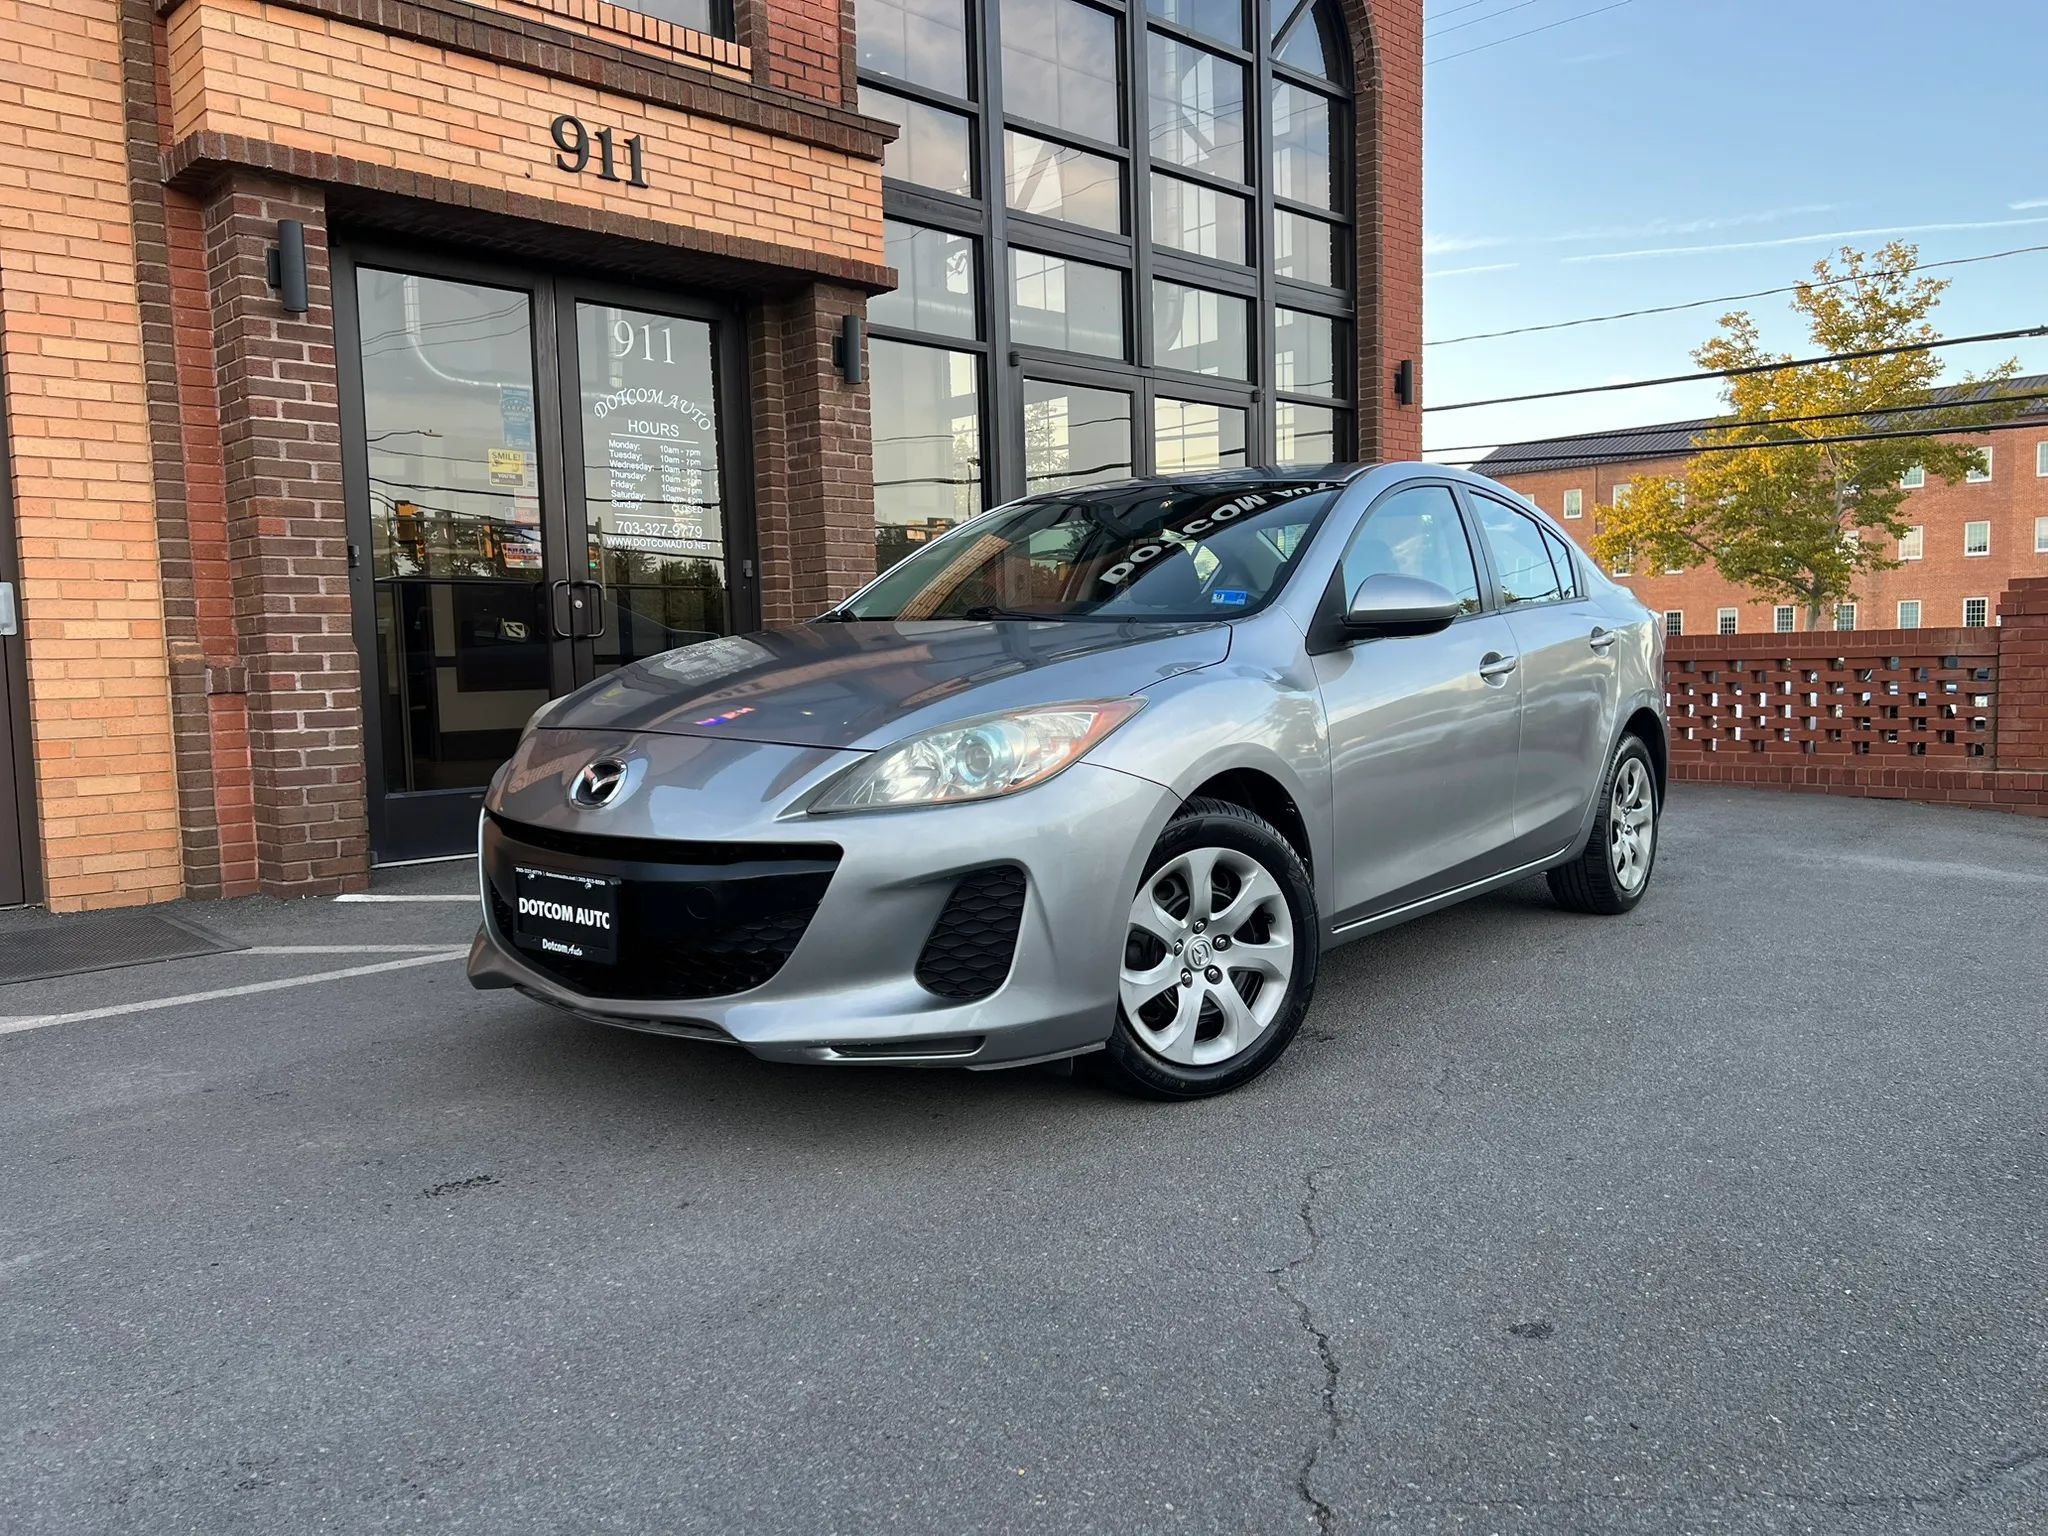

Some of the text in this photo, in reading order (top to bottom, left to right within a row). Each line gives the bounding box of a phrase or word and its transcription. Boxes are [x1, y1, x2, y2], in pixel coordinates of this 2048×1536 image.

[551, 115, 649, 189] 911
[613, 320, 676, 365] 911
[594, 387, 711, 431] DOTCOM AUTO
[628, 420, 679, 437] HOURS
[609, 440, 640, 450] Monday:
[660, 445, 679, 454] 10am
[492, 451, 520, 461] SMILE!
[609, 450, 642, 460] Tuesday:
[661, 455, 680, 464] 10am
[609, 460, 655, 471] Wednesday:
[661, 465, 680, 474] 10am
[610, 469, 647, 481] Thursday:
[661, 475, 681, 483] 10am
[610, 480, 636, 490] Friday:
[662, 484, 681, 493] 10am
[611, 490, 646, 500] Saturday:
[662, 494, 681, 502] 10am
[611, 500, 704, 514] Sunday: CLOSED
[616, 521, 703, 538] 703-327-9779
[606, 536, 712, 550] WWW.DOTCOMAUTO.NET
[518, 897, 574, 923] DOTCOM
